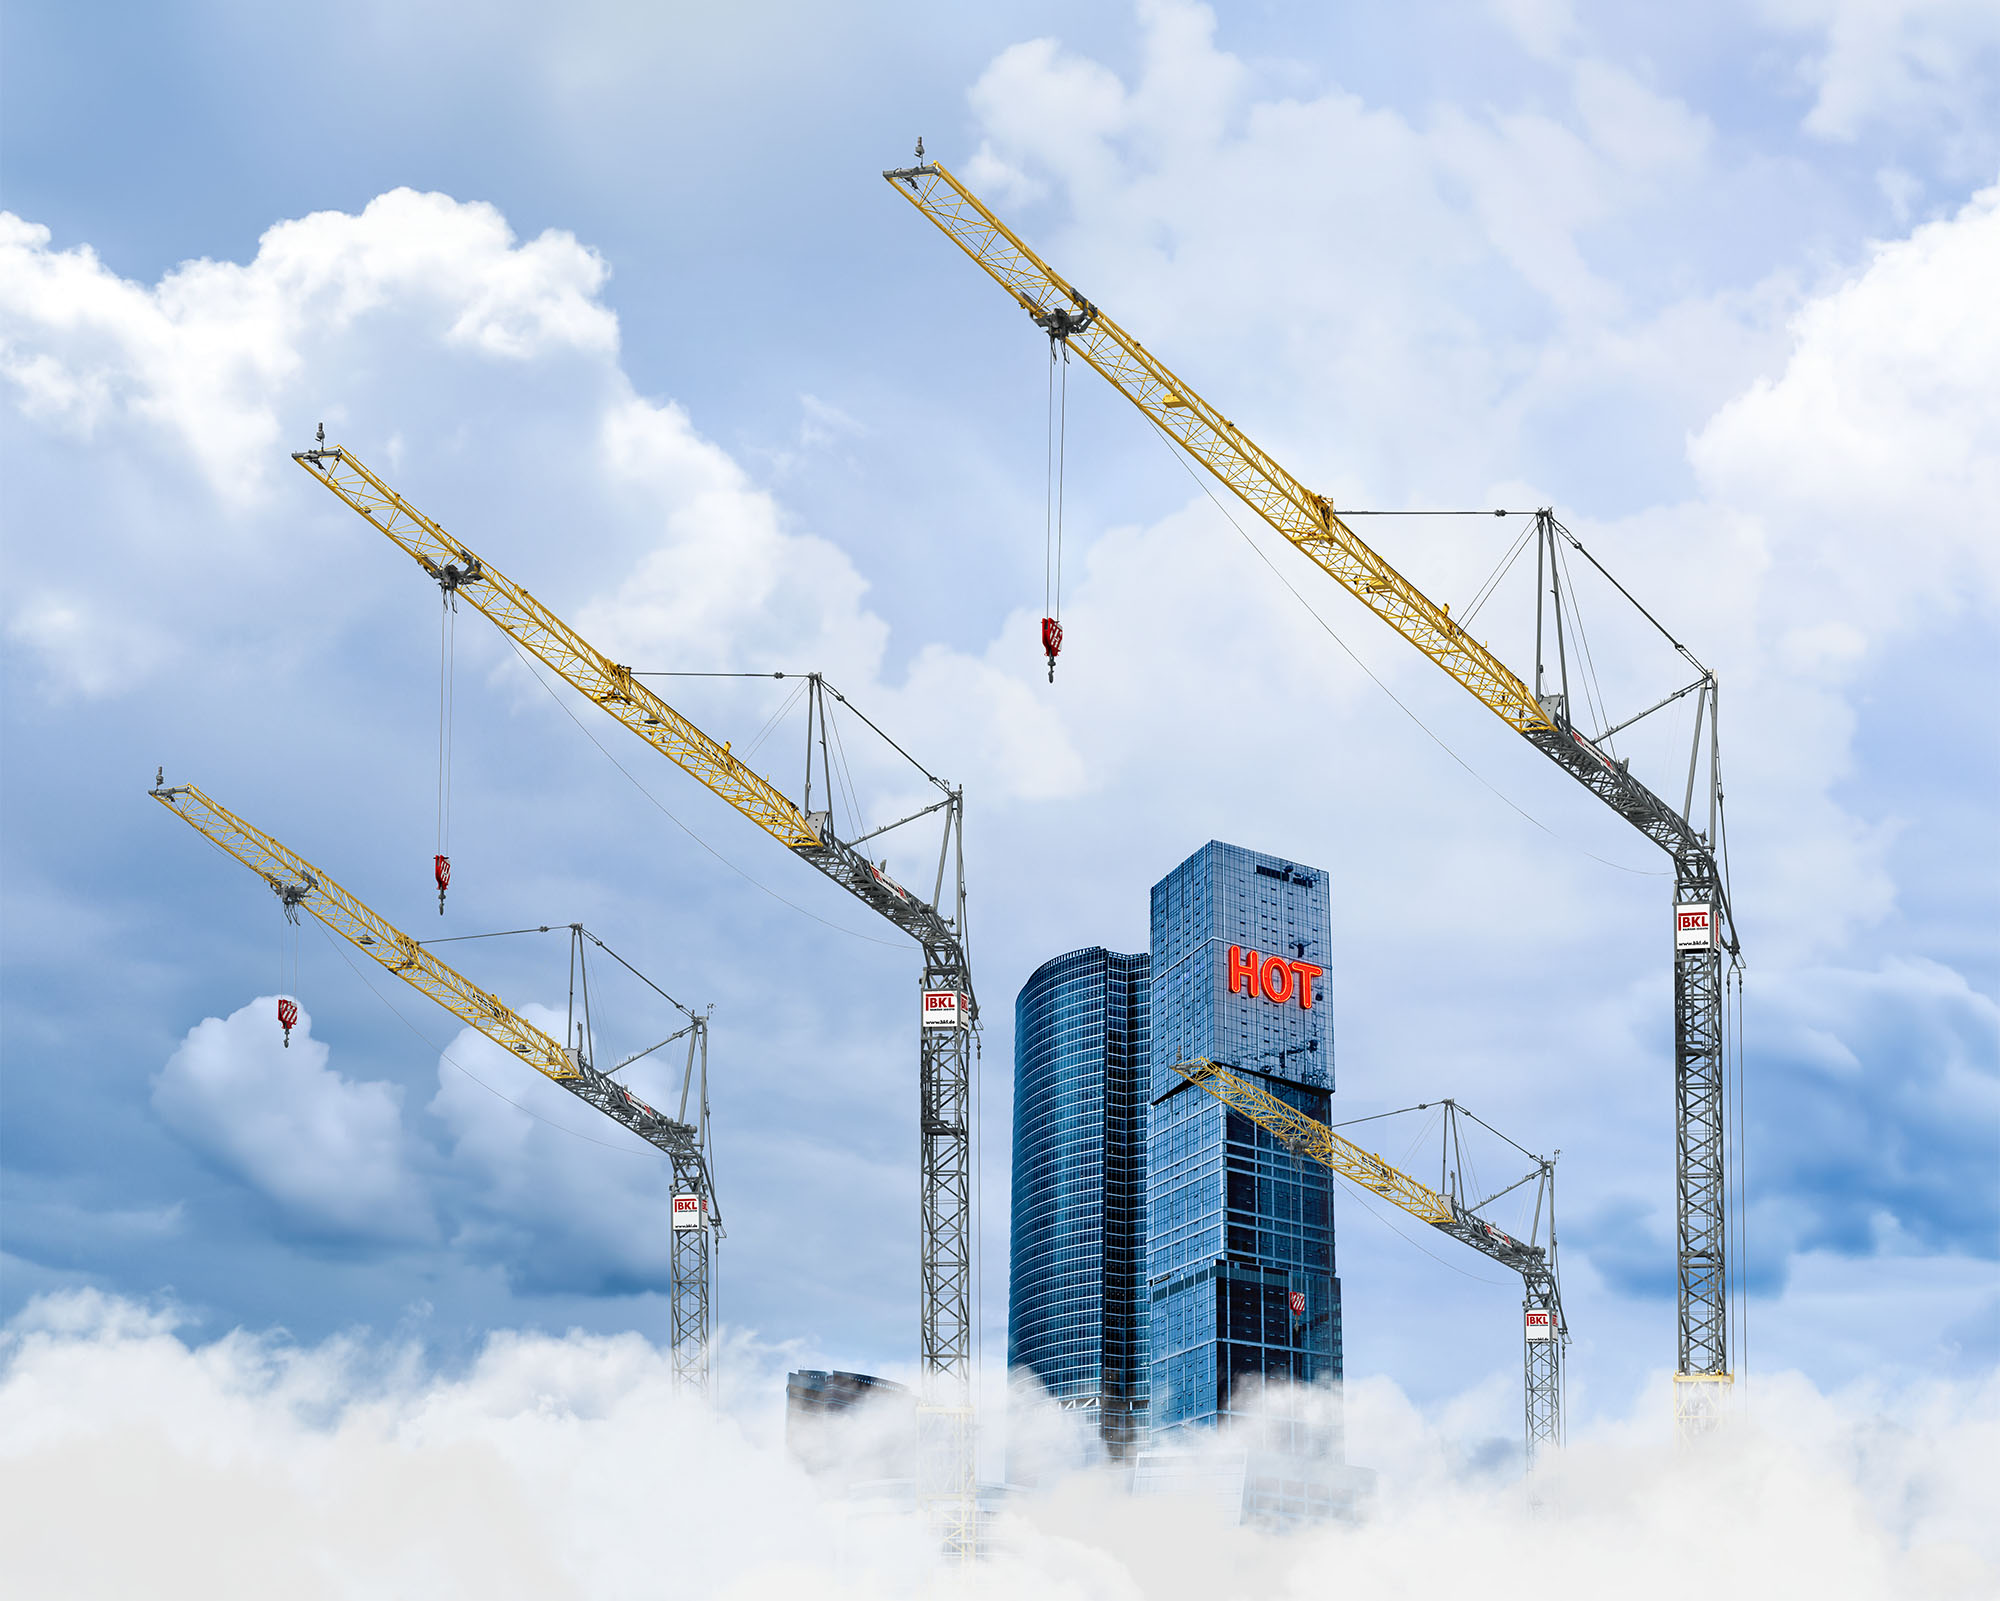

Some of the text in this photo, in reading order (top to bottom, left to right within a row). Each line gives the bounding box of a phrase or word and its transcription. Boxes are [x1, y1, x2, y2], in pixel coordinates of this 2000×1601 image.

[1682, 916, 1709, 927] BKL
[1228, 945, 1323, 1010] HOT
[930, 997, 955, 1008] BKL
[677, 1201, 698, 1210] BKL
[1529, 1316, 1548, 1324] BKL
